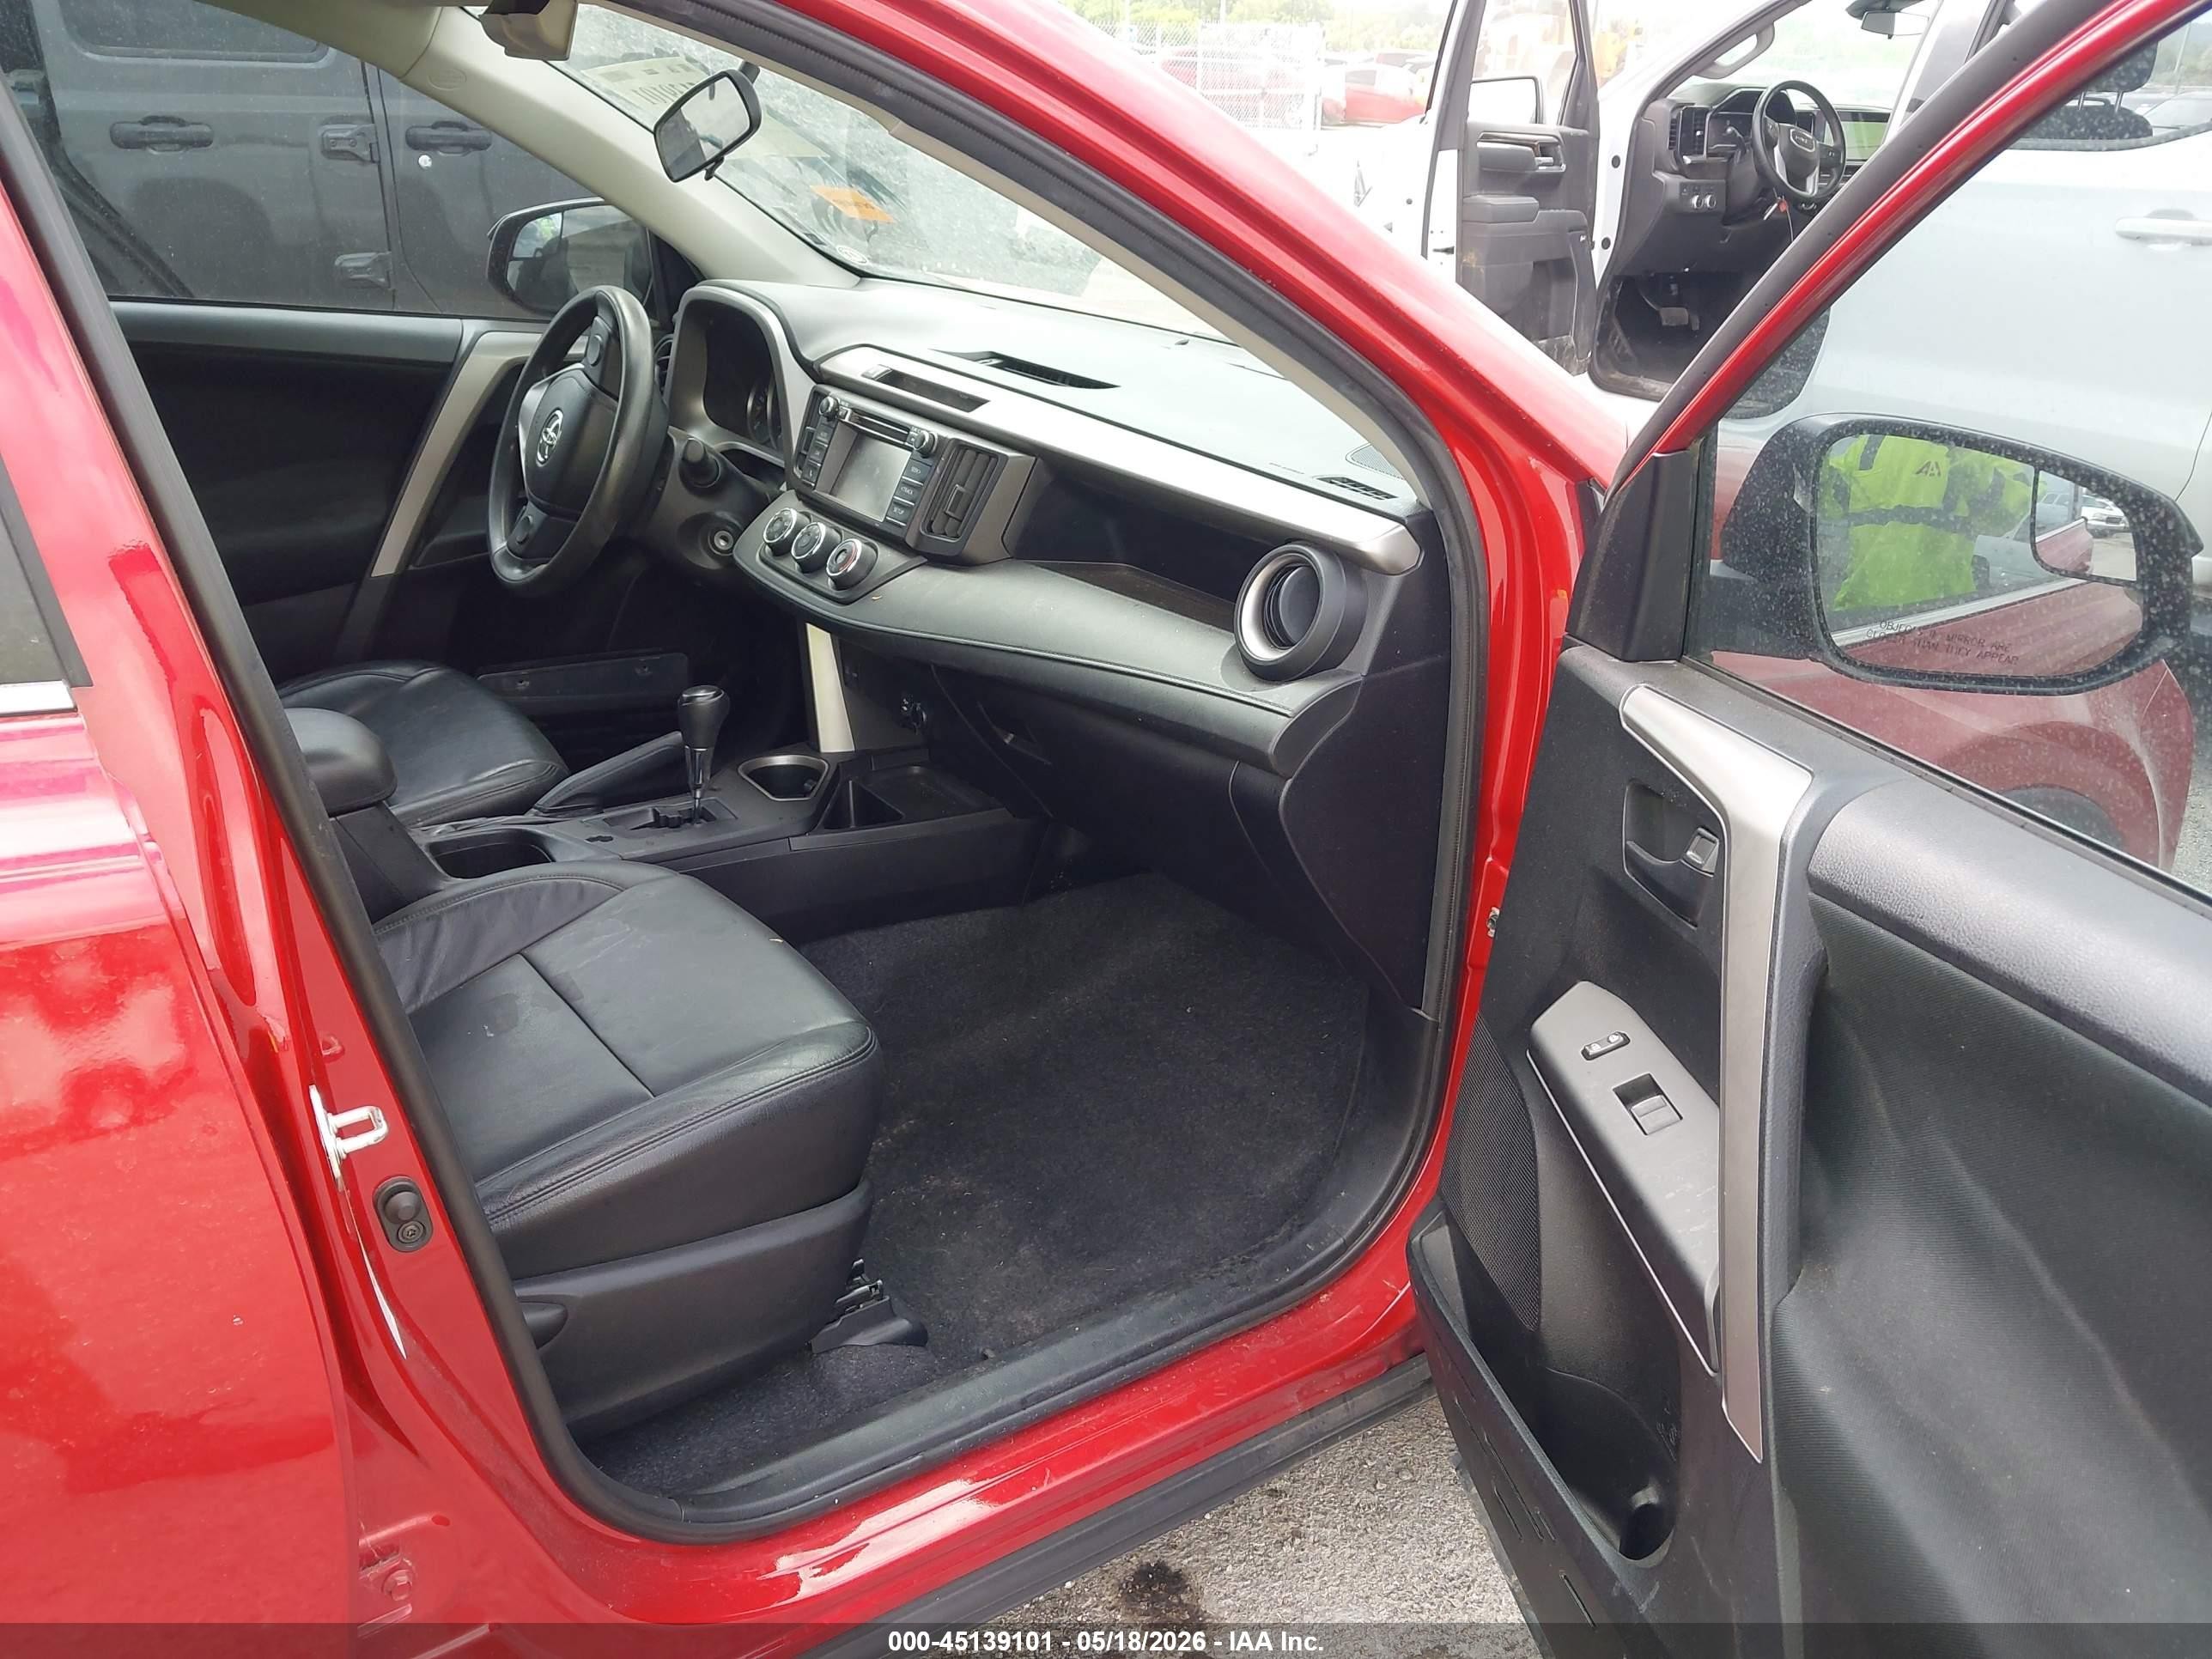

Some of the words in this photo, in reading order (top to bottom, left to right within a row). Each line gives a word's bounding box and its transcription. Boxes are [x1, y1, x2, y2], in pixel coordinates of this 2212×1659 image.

[1866, 629, 1905, 644] CLOR
[1976, 650, 2020, 665] APPEAR
[1946, 634, 1985, 647] MIRROR
